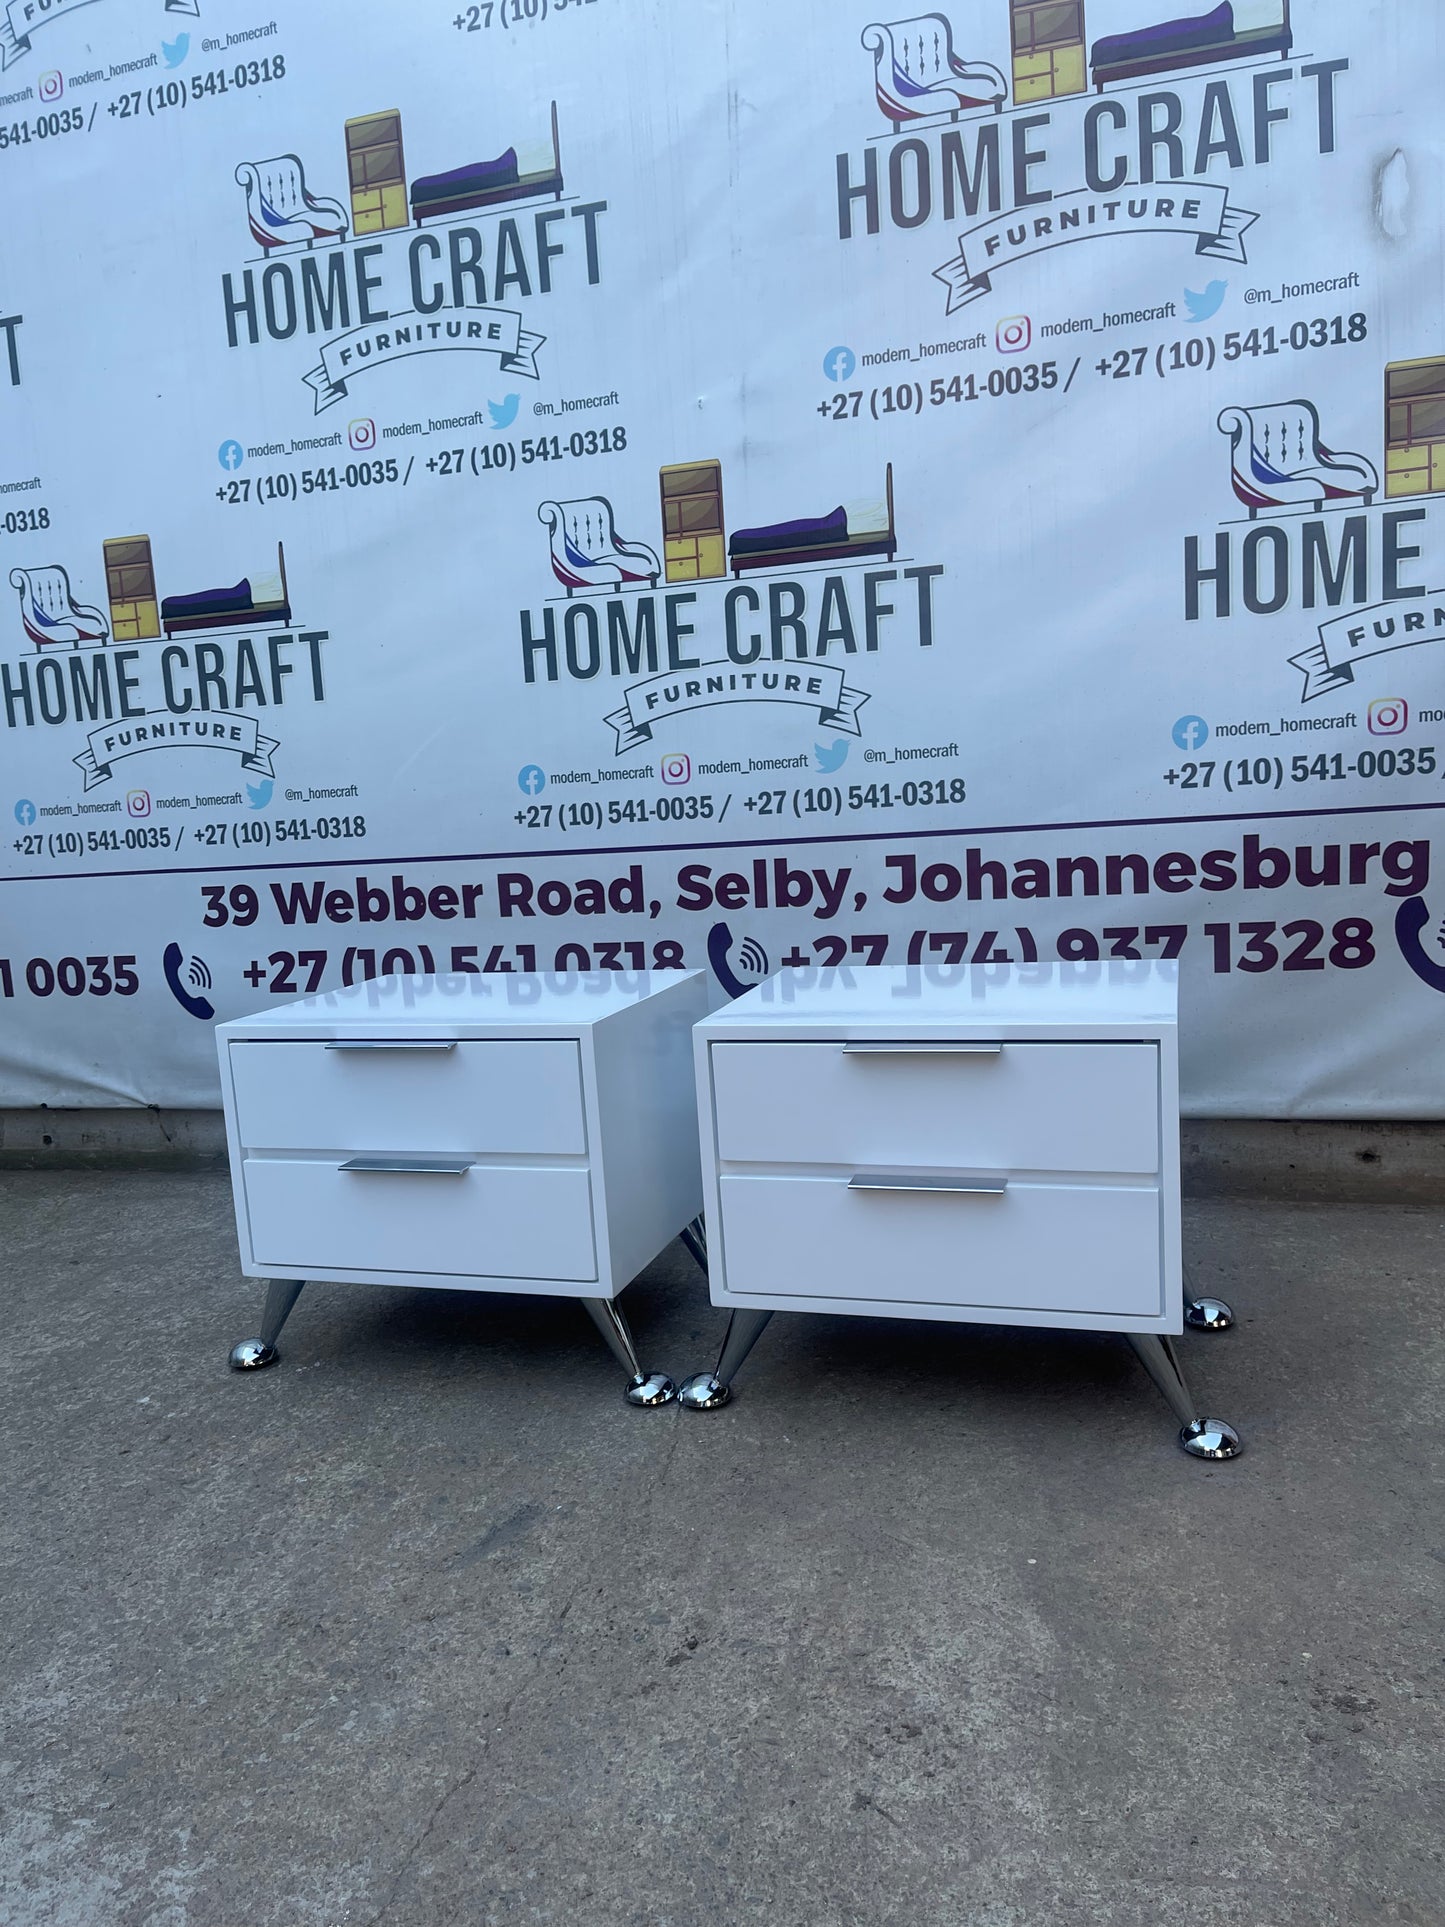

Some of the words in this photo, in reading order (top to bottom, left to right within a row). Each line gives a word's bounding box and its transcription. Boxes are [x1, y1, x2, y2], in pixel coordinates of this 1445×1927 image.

[202, 21, 277, 52] @m_homecraft
[453, 2, 493, 32] +27
[108, 91, 141, 118] +27
[147, 80, 186, 116] (10)
[192, 55, 285, 99] 541-0318
[836, 113, 1052, 240] HOME
[1084, 58, 1349, 192] CRAFT
[984, 199, 1200, 257] FURNITURE
[222, 244, 391, 351] HOME
[409, 200, 607, 314] CRAFT
[1244, 272, 1359, 304] @m_homecraft
[340, 321, 501, 366] FURNITURE
[817, 391, 863, 420] +27
[871, 383, 922, 420] (10)
[930, 361, 1058, 405] 541-0035
[1095, 347, 1148, 379] +27
[1156, 337, 1215, 378] (10)
[1224, 313, 1367, 360] 541-0318
[533, 391, 619, 416] @m_homecraft
[216, 479, 250, 504] +27
[257, 473, 297, 505] (10)
[302, 459, 398, 493] 541-0035
[426, 449, 464, 475] +27
[471, 442, 516, 471] (10)
[522, 426, 627, 464] 541-0318
[1, 508, 50, 533] -0318
[1185, 508, 1425, 620] HOME
[520, 592, 700, 683] HOME
[725, 564, 944, 664] CRAFT
[1, 650, 146, 728] HOME
[162, 631, 329, 714] CRAFT
[645, 673, 822, 709] FURNITURE
[104, 722, 241, 752] FURNITURE
[864, 743, 959, 764] @m_homecraft
[285, 785, 358, 802] @m_homecraft
[1163, 762, 1215, 789] +27
[1224, 757, 1283, 792] (10)
[1291, 747, 1436, 782] 541-0035
[514, 805, 552, 828] +27
[559, 802, 602, 831] (10)
[608, 795, 713, 823] 541-0035
[744, 791, 786, 815] +27
[793, 787, 841, 818] (10)
[848, 779, 966, 809] 541-0318
[13, 835, 43, 855] +27
[49, 832, 83, 858] (10)
[88, 827, 170, 851] 541-0035
[194, 824, 227, 845] +27
[233, 822, 270, 848] (10)
[276, 816, 366, 841] 541-0318
[201, 884, 259, 927] 39
[269, 875, 483, 924] Webber
[497, 865, 661, 919] Road,
[676, 858, 867, 919] Selby,
[883, 834, 1431, 897] Johannesburg
[243, 950, 327, 993] +27
[342, 945, 435, 987] (10)
[451, 944, 536, 973] 541
[555, 940, 686, 972] 0318
[781, 934, 888, 967] +27
[907, 927, 1038, 965] (74)
[1057, 925, 1187, 961] 937
[1204, 918, 1375, 973] 1328
[26, 955, 139, 997] 0035
